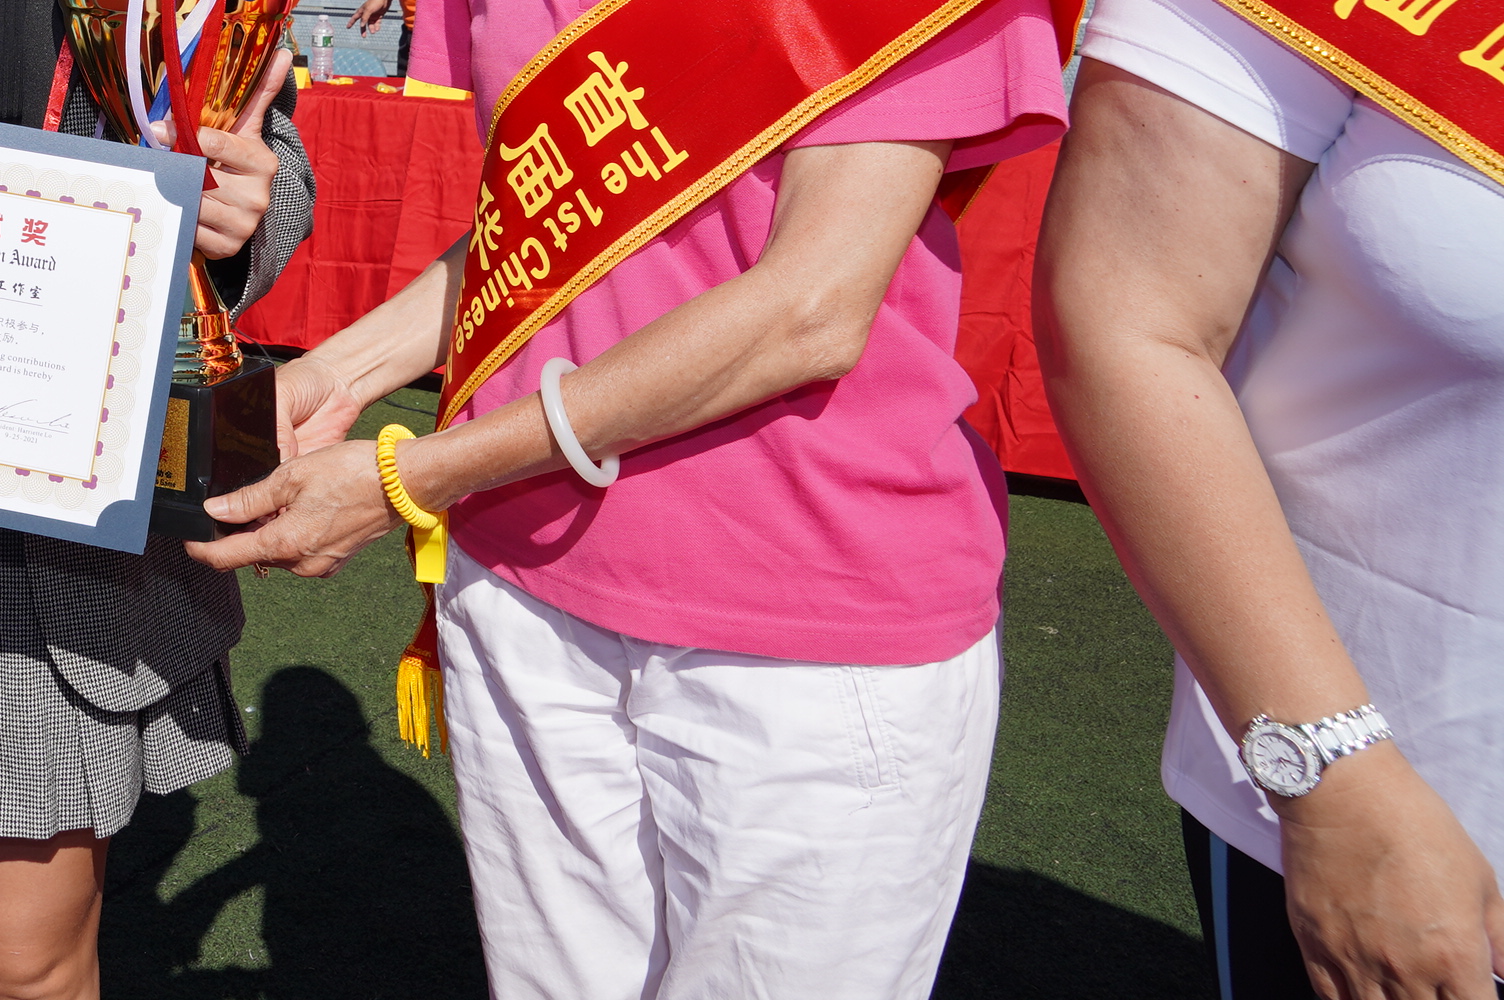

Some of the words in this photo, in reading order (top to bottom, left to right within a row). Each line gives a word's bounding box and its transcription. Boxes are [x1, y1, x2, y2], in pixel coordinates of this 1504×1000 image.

[601, 126, 689, 195] The
[543, 189, 603, 253] 1st
[9, 249, 57, 272] Award
[455, 236, 551, 355] Chinese
[7, 355, 66, 371] contributions
[14, 366, 21, 375] is
[23, 368, 53, 382] hereby
